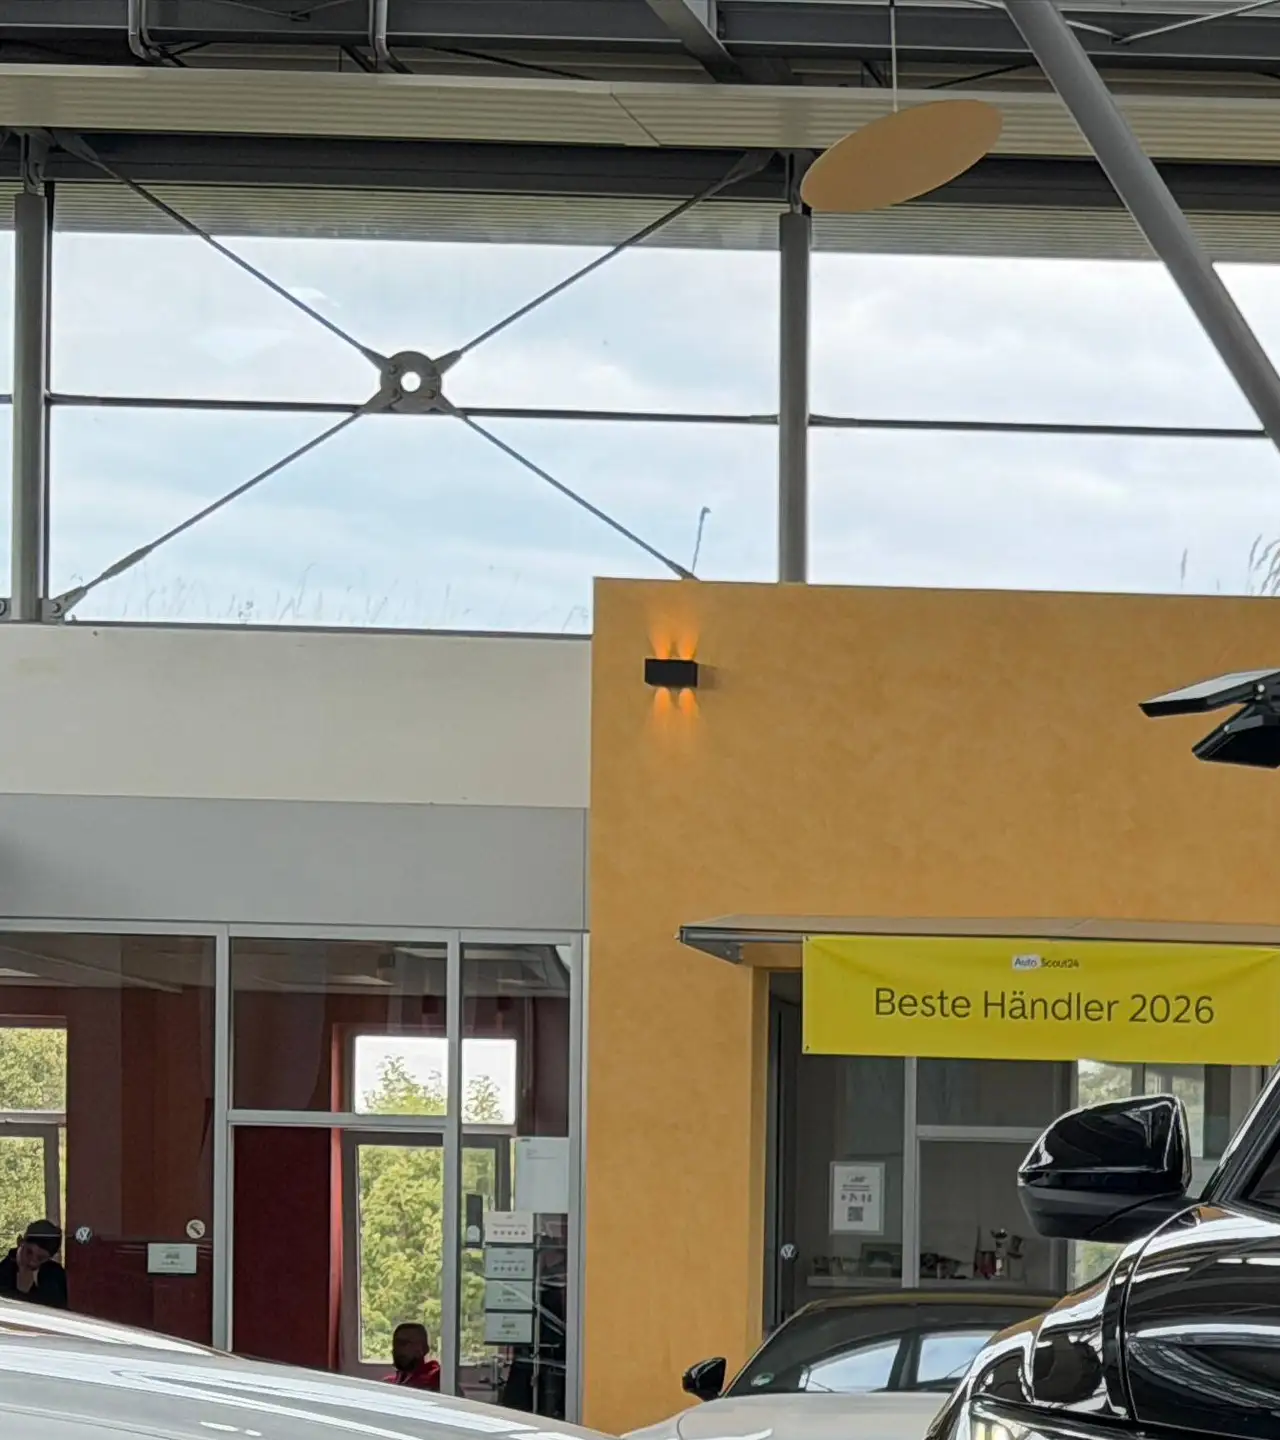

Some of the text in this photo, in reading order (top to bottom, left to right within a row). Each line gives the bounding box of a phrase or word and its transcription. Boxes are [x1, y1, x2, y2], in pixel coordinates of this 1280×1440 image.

[874, 987, 1215, 1025] Beste Händler 2026
